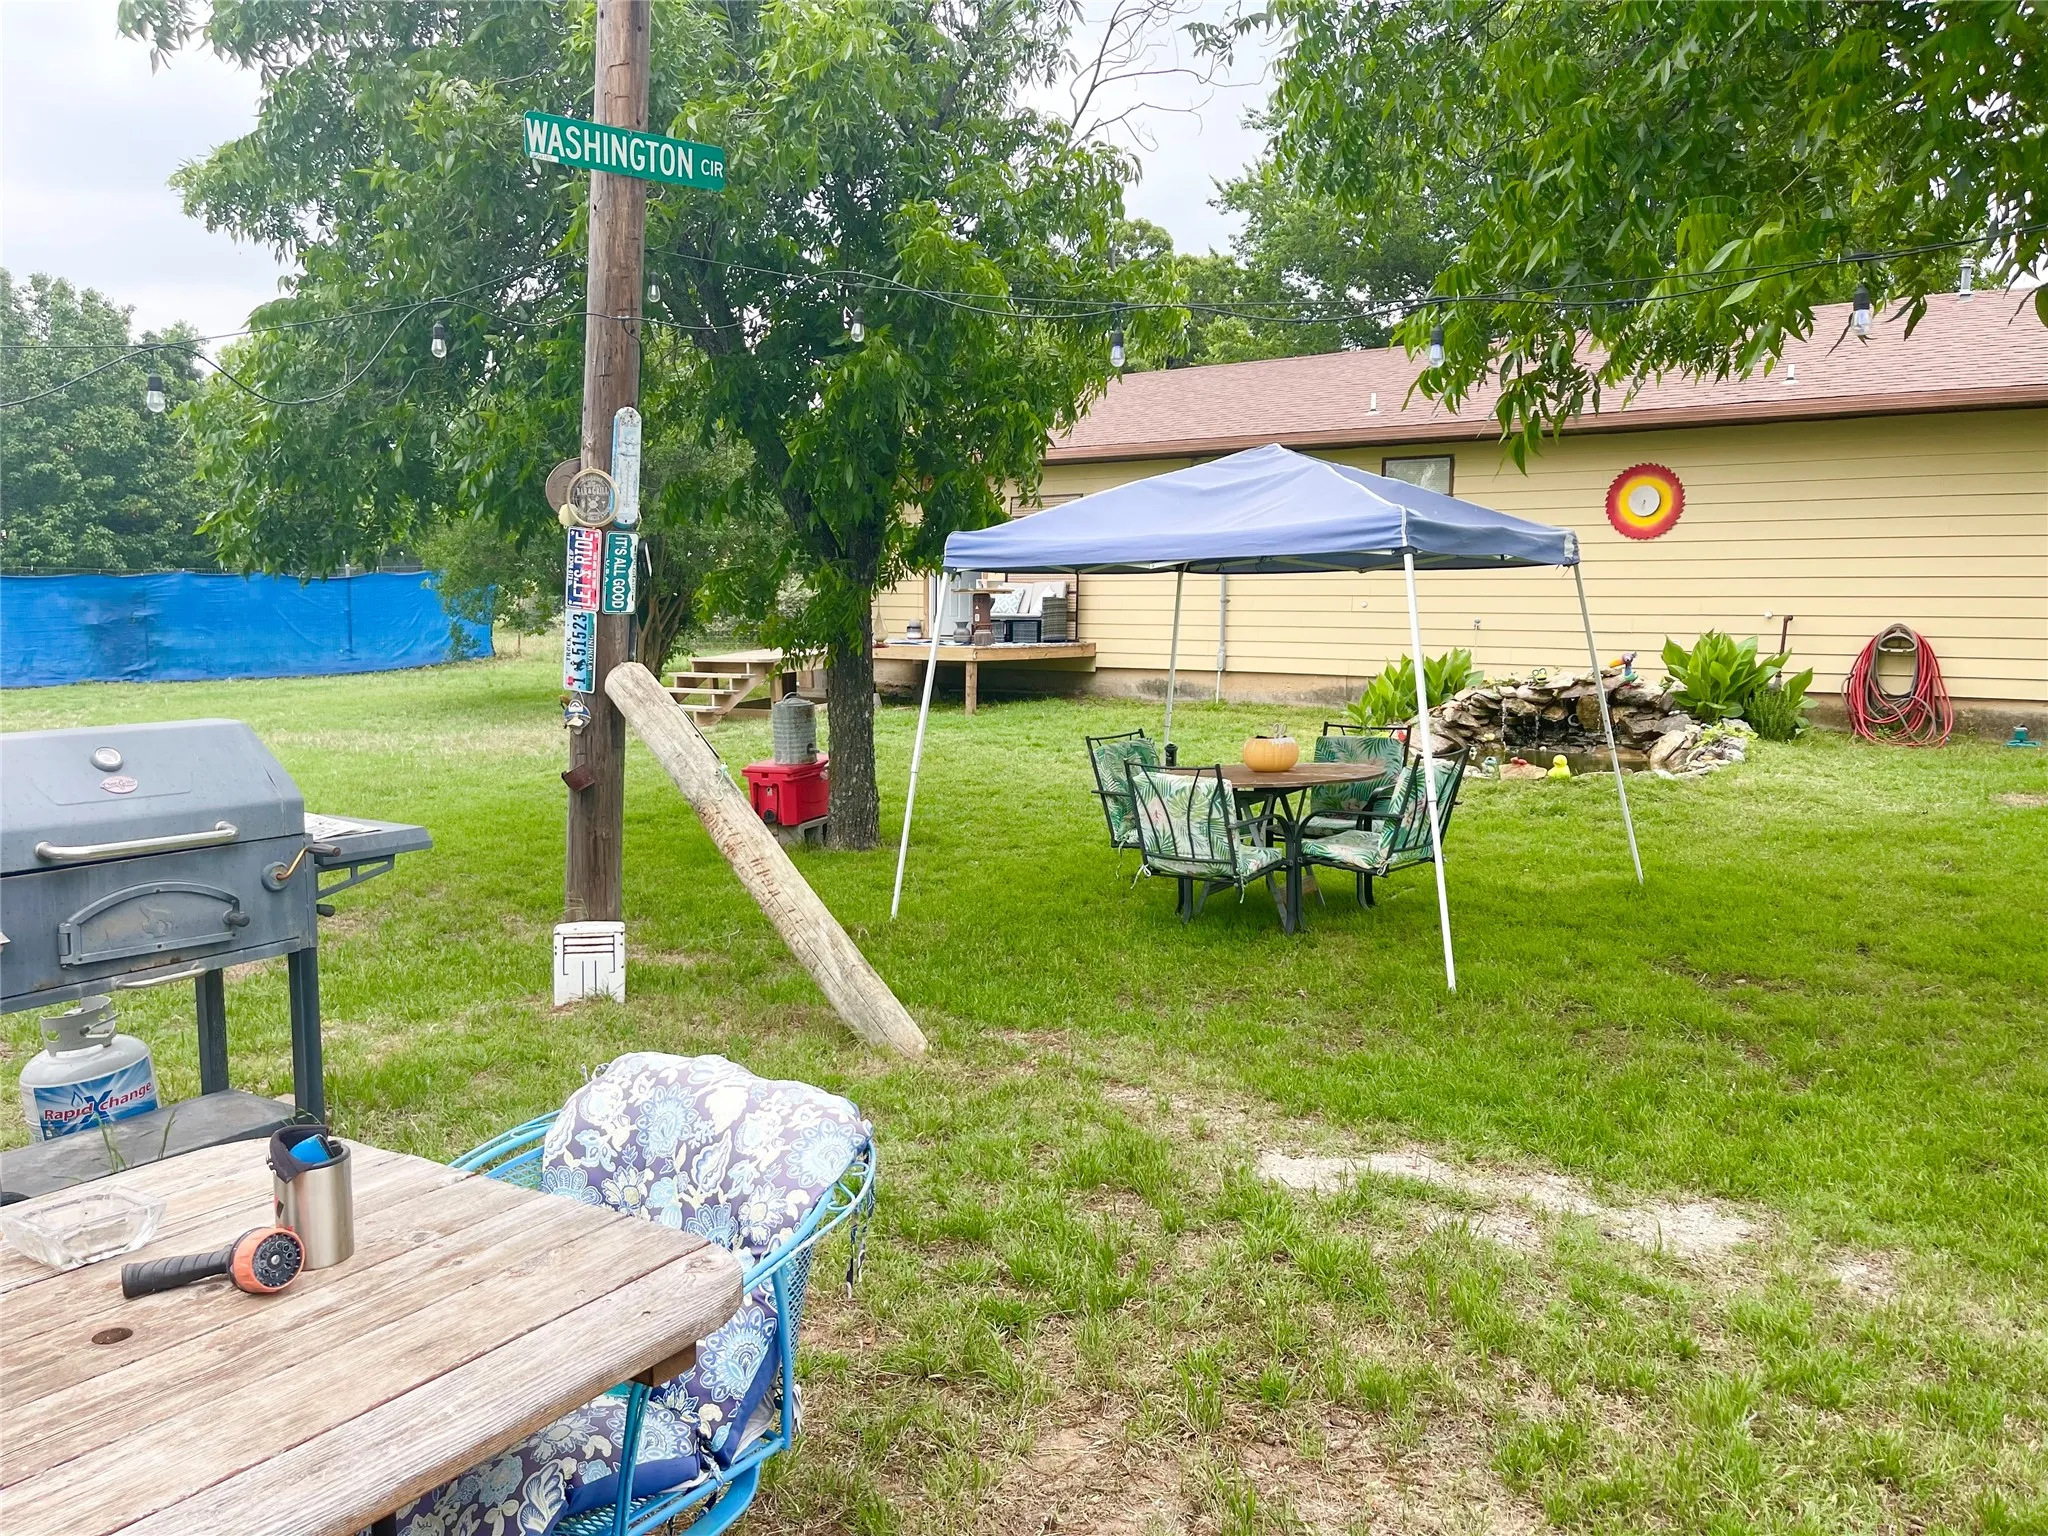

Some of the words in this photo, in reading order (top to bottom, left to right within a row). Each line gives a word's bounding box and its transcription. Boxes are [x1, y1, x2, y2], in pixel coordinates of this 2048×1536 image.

[526, 118, 693, 179] WASHINGTON
[701, 159, 723, 178] CIR
[574, 531, 594, 565] RIDE
[615, 537, 628, 556] IT'S
[613, 557, 627, 576] ALL
[573, 569, 592, 607] LET'S
[611, 578, 626, 609] GOOD
[571, 613, 587, 656] 51523
[44, 1101, 94, 1123] Rapid
